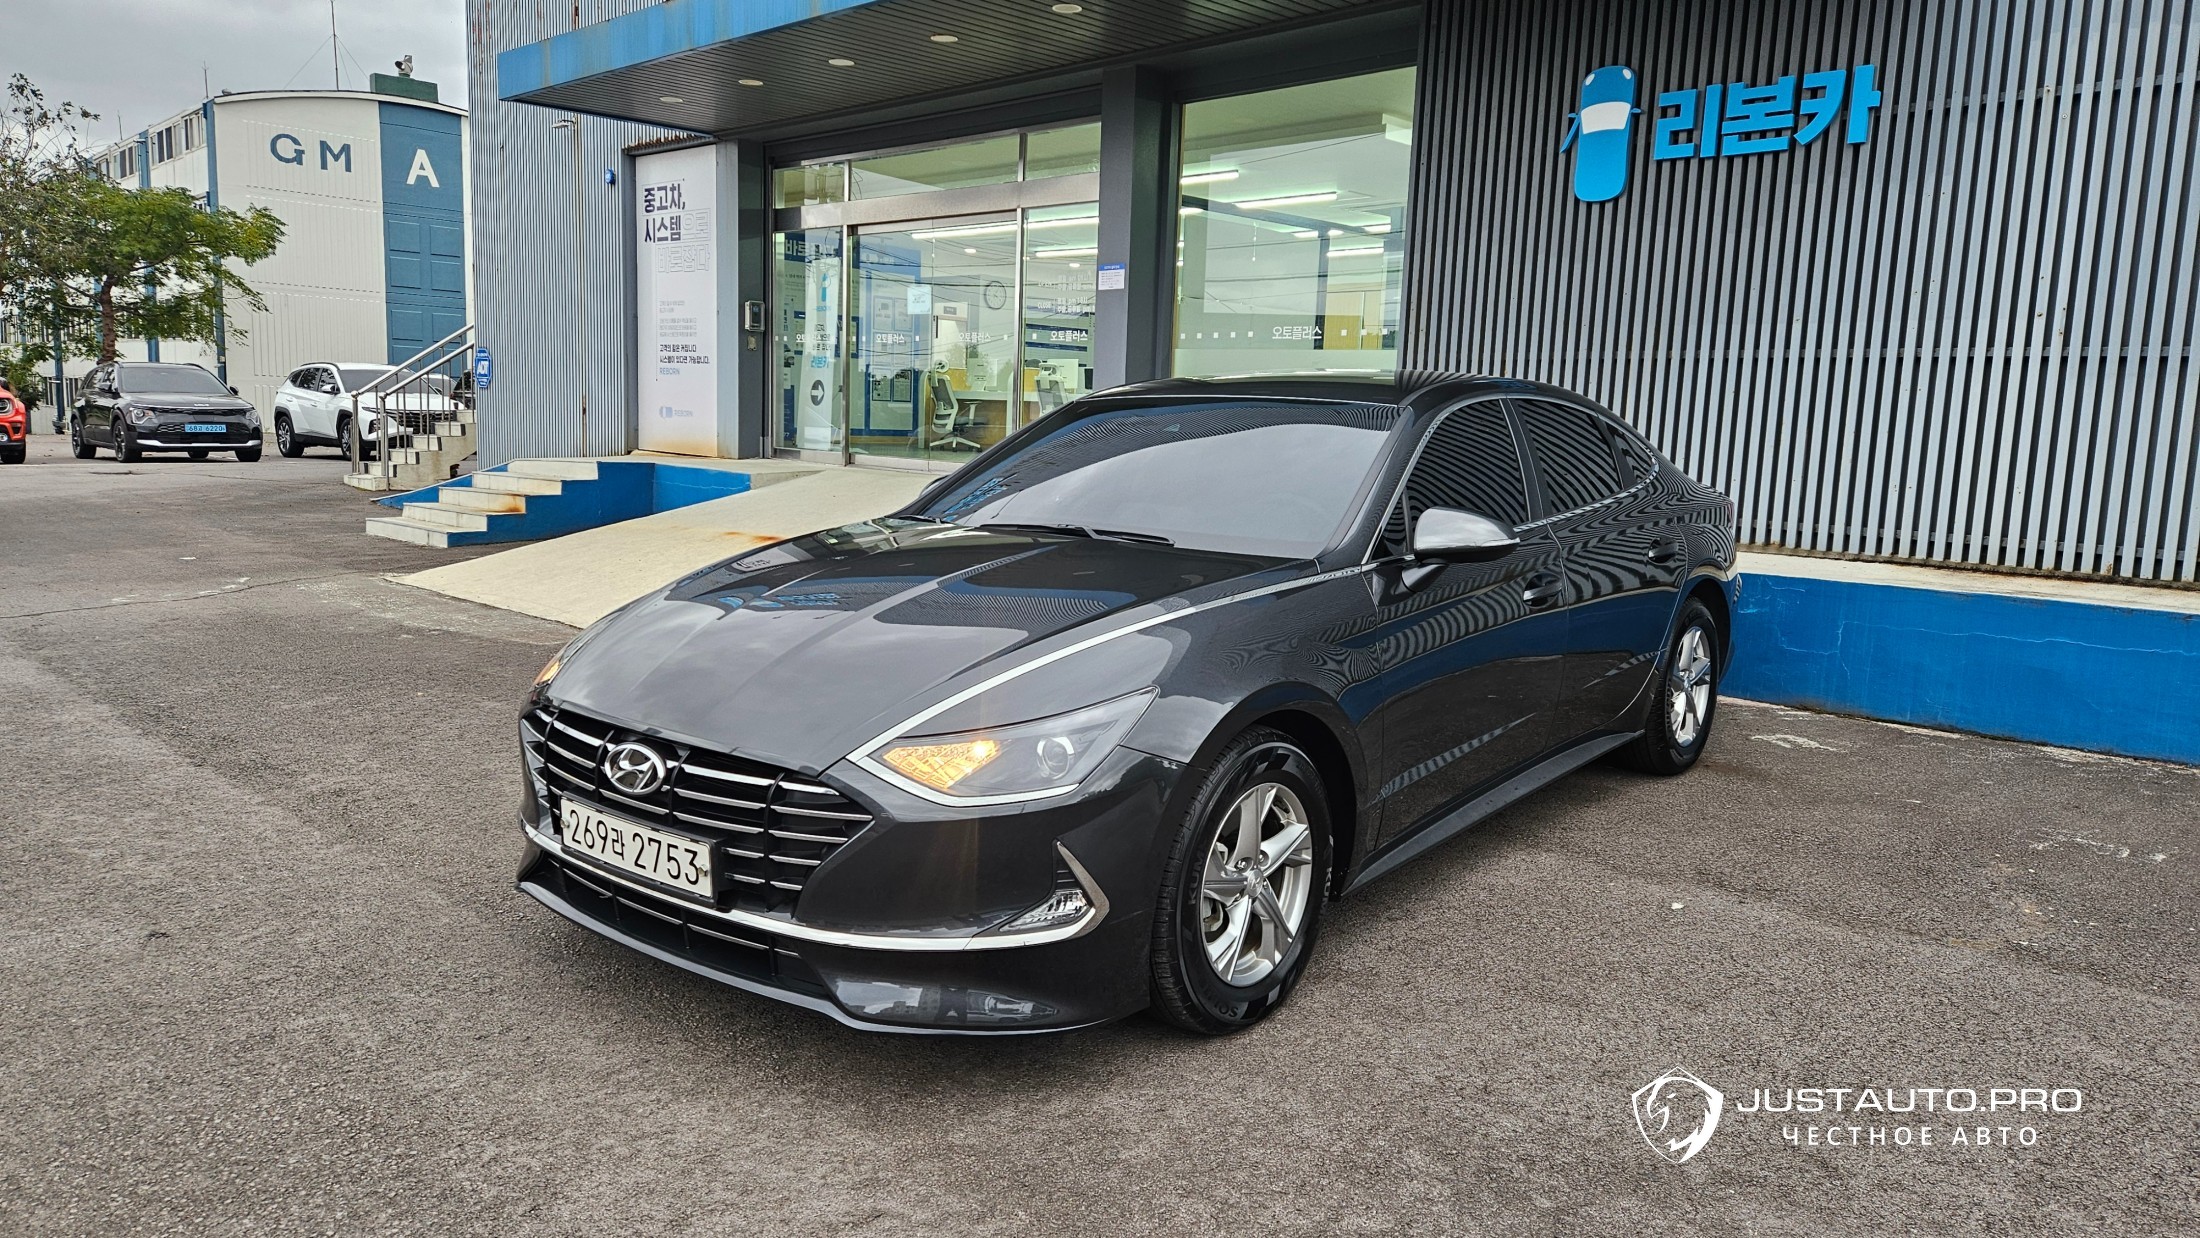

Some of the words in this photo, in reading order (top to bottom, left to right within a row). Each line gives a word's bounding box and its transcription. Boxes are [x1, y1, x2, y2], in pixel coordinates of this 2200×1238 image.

[1653, 64, 1881, 160] 리본카
[270, 133, 352, 173] GM
[406, 148, 440, 188] A
[643, 183, 685, 213] 중고차,
[644, 210, 709, 243] 시스템으로
[875, 333, 905, 344] 오토플러스
[959, 332, 992, 343] 오토플러스
[1050, 330, 1088, 342] 오토플러스
[1272, 326, 1322, 340] 오토플러스
[659, 367, 680, 375] REBORN
[570, 809, 625, 861] 269라
[632, 832, 700, 886] 2753
